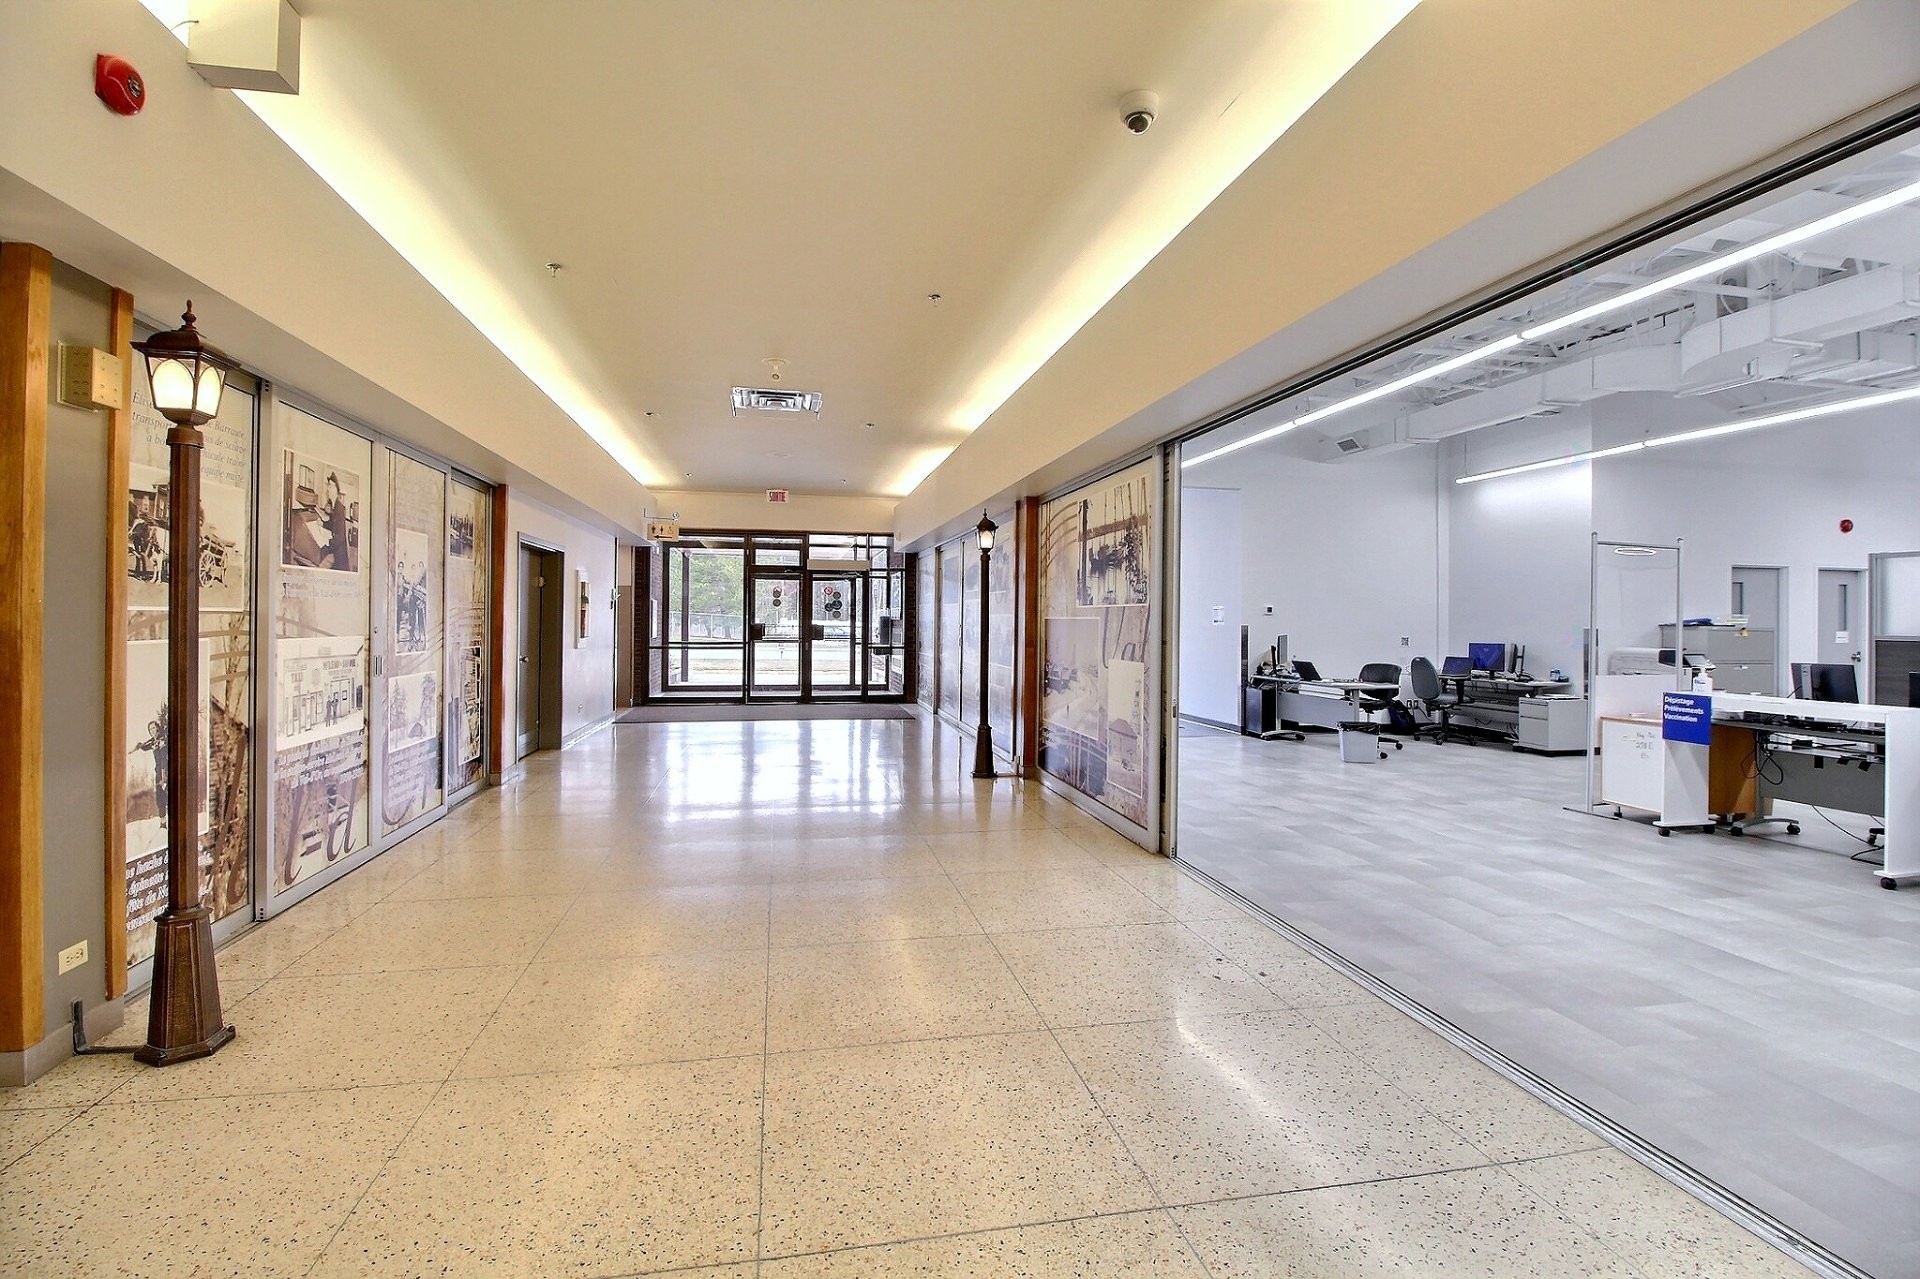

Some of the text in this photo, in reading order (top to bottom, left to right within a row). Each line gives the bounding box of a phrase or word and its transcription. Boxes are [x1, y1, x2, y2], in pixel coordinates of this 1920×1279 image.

[769, 491, 786, 503] SORTIE
[1664, 695, 1695, 706] Dépistage
[1664, 704, 1704, 715] Prélèvements
[1663, 712, 1698, 723] Vaccination
